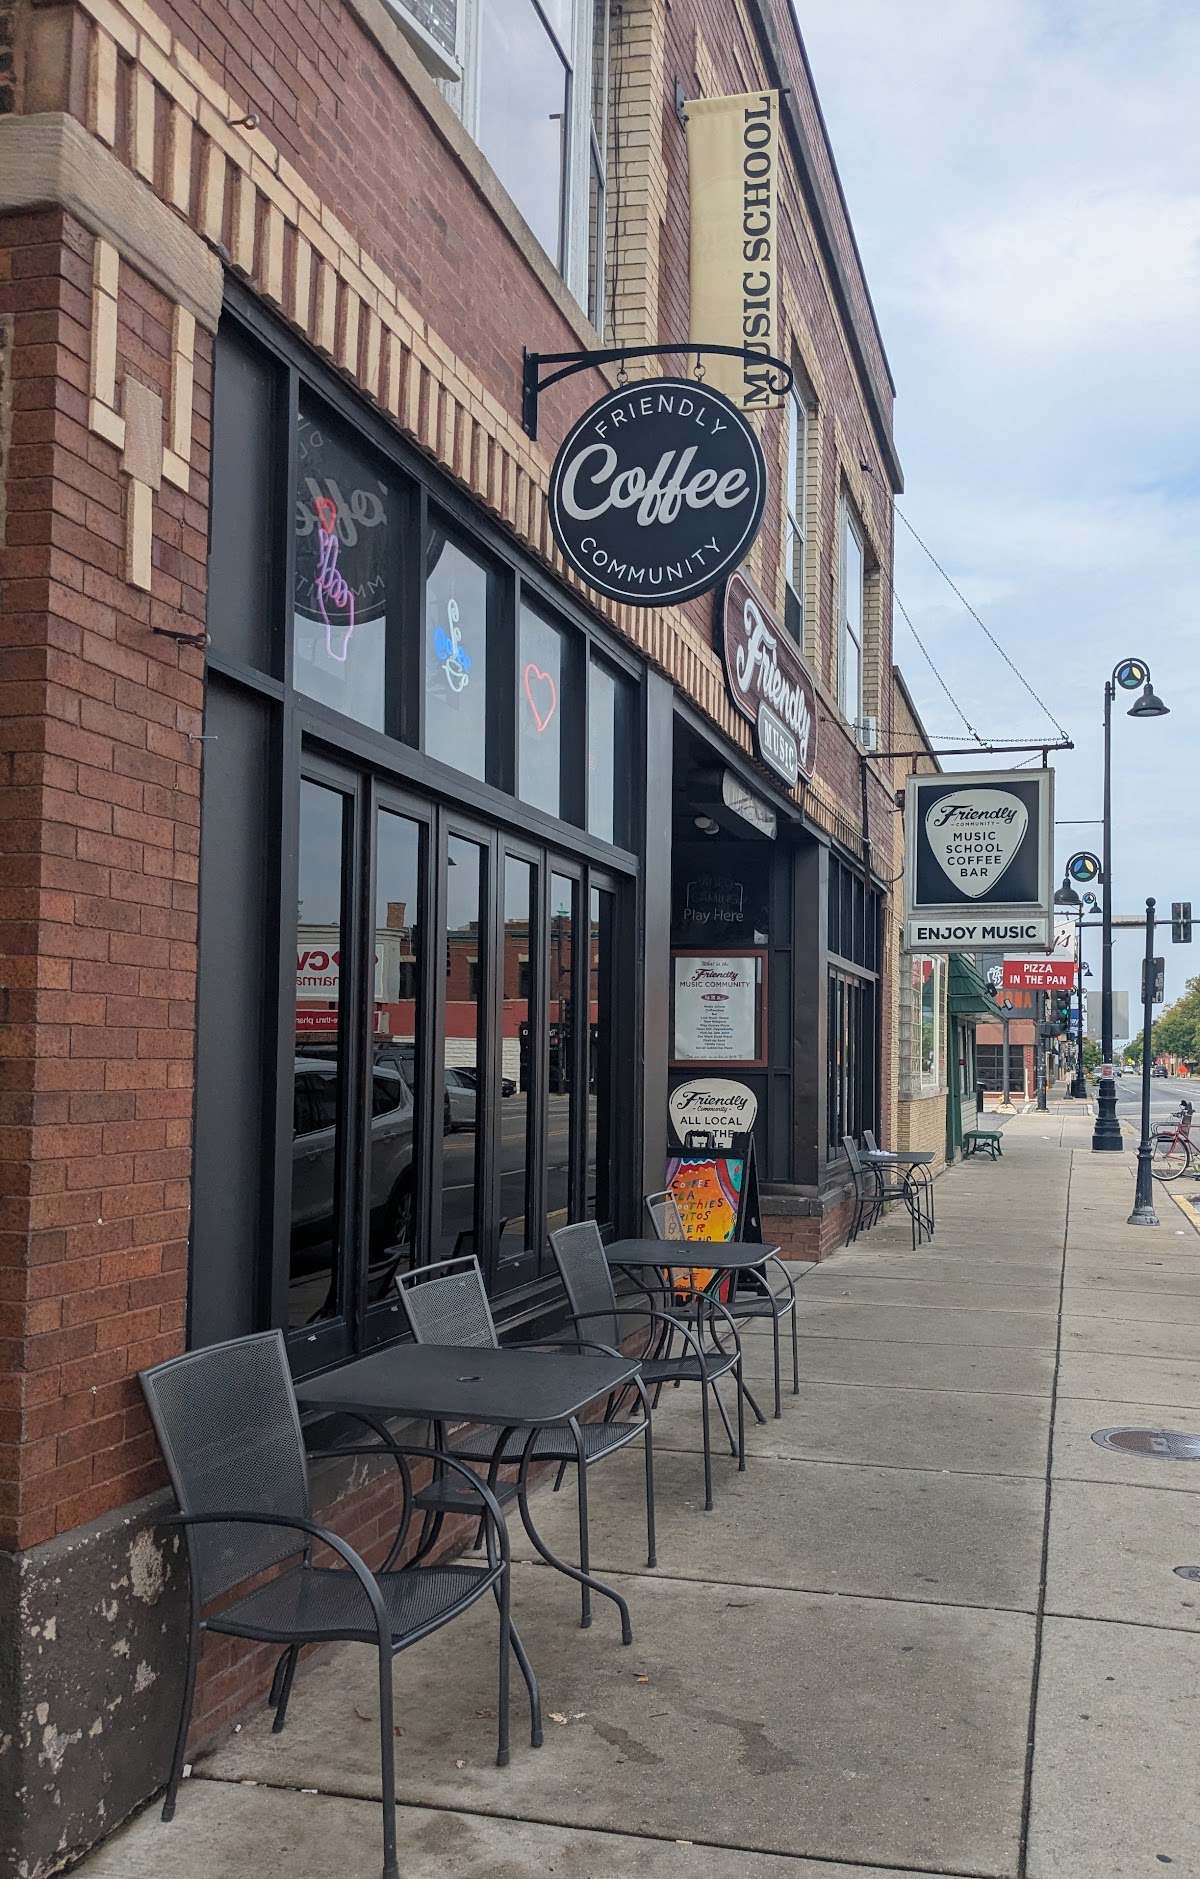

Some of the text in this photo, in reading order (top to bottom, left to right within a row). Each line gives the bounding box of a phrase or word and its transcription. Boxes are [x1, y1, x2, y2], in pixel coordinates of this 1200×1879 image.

[743, 96, 772, 407] MUSIC SCHOOL
[594, 395, 728, 439] FRIENDLY
[562, 442, 750, 526] Coffee
[580, 537, 721, 585] COMMUNITY
[736, 598, 811, 767] Friendly
[763, 719, 795, 770] MUSIC
[933, 804, 1018, 827] Friendly
[953, 831, 996, 842] MUSIC
[946, 842, 1004, 854] SCHOOL
[947, 855, 1003, 866] COFFEE
[960, 867, 988, 877] BAR
[683, 907, 744, 924] Play Here
[917, 925, 1037, 940] ENJOY MUSIC
[1023, 963, 1053, 973] PIZZA
[1010, 974, 1067, 985] IN THE PAN
[676, 1091, 748, 1110] Friendly
[680, 1116, 743, 1126] ALL LOCAL
[712, 1130, 735, 1138] THE
